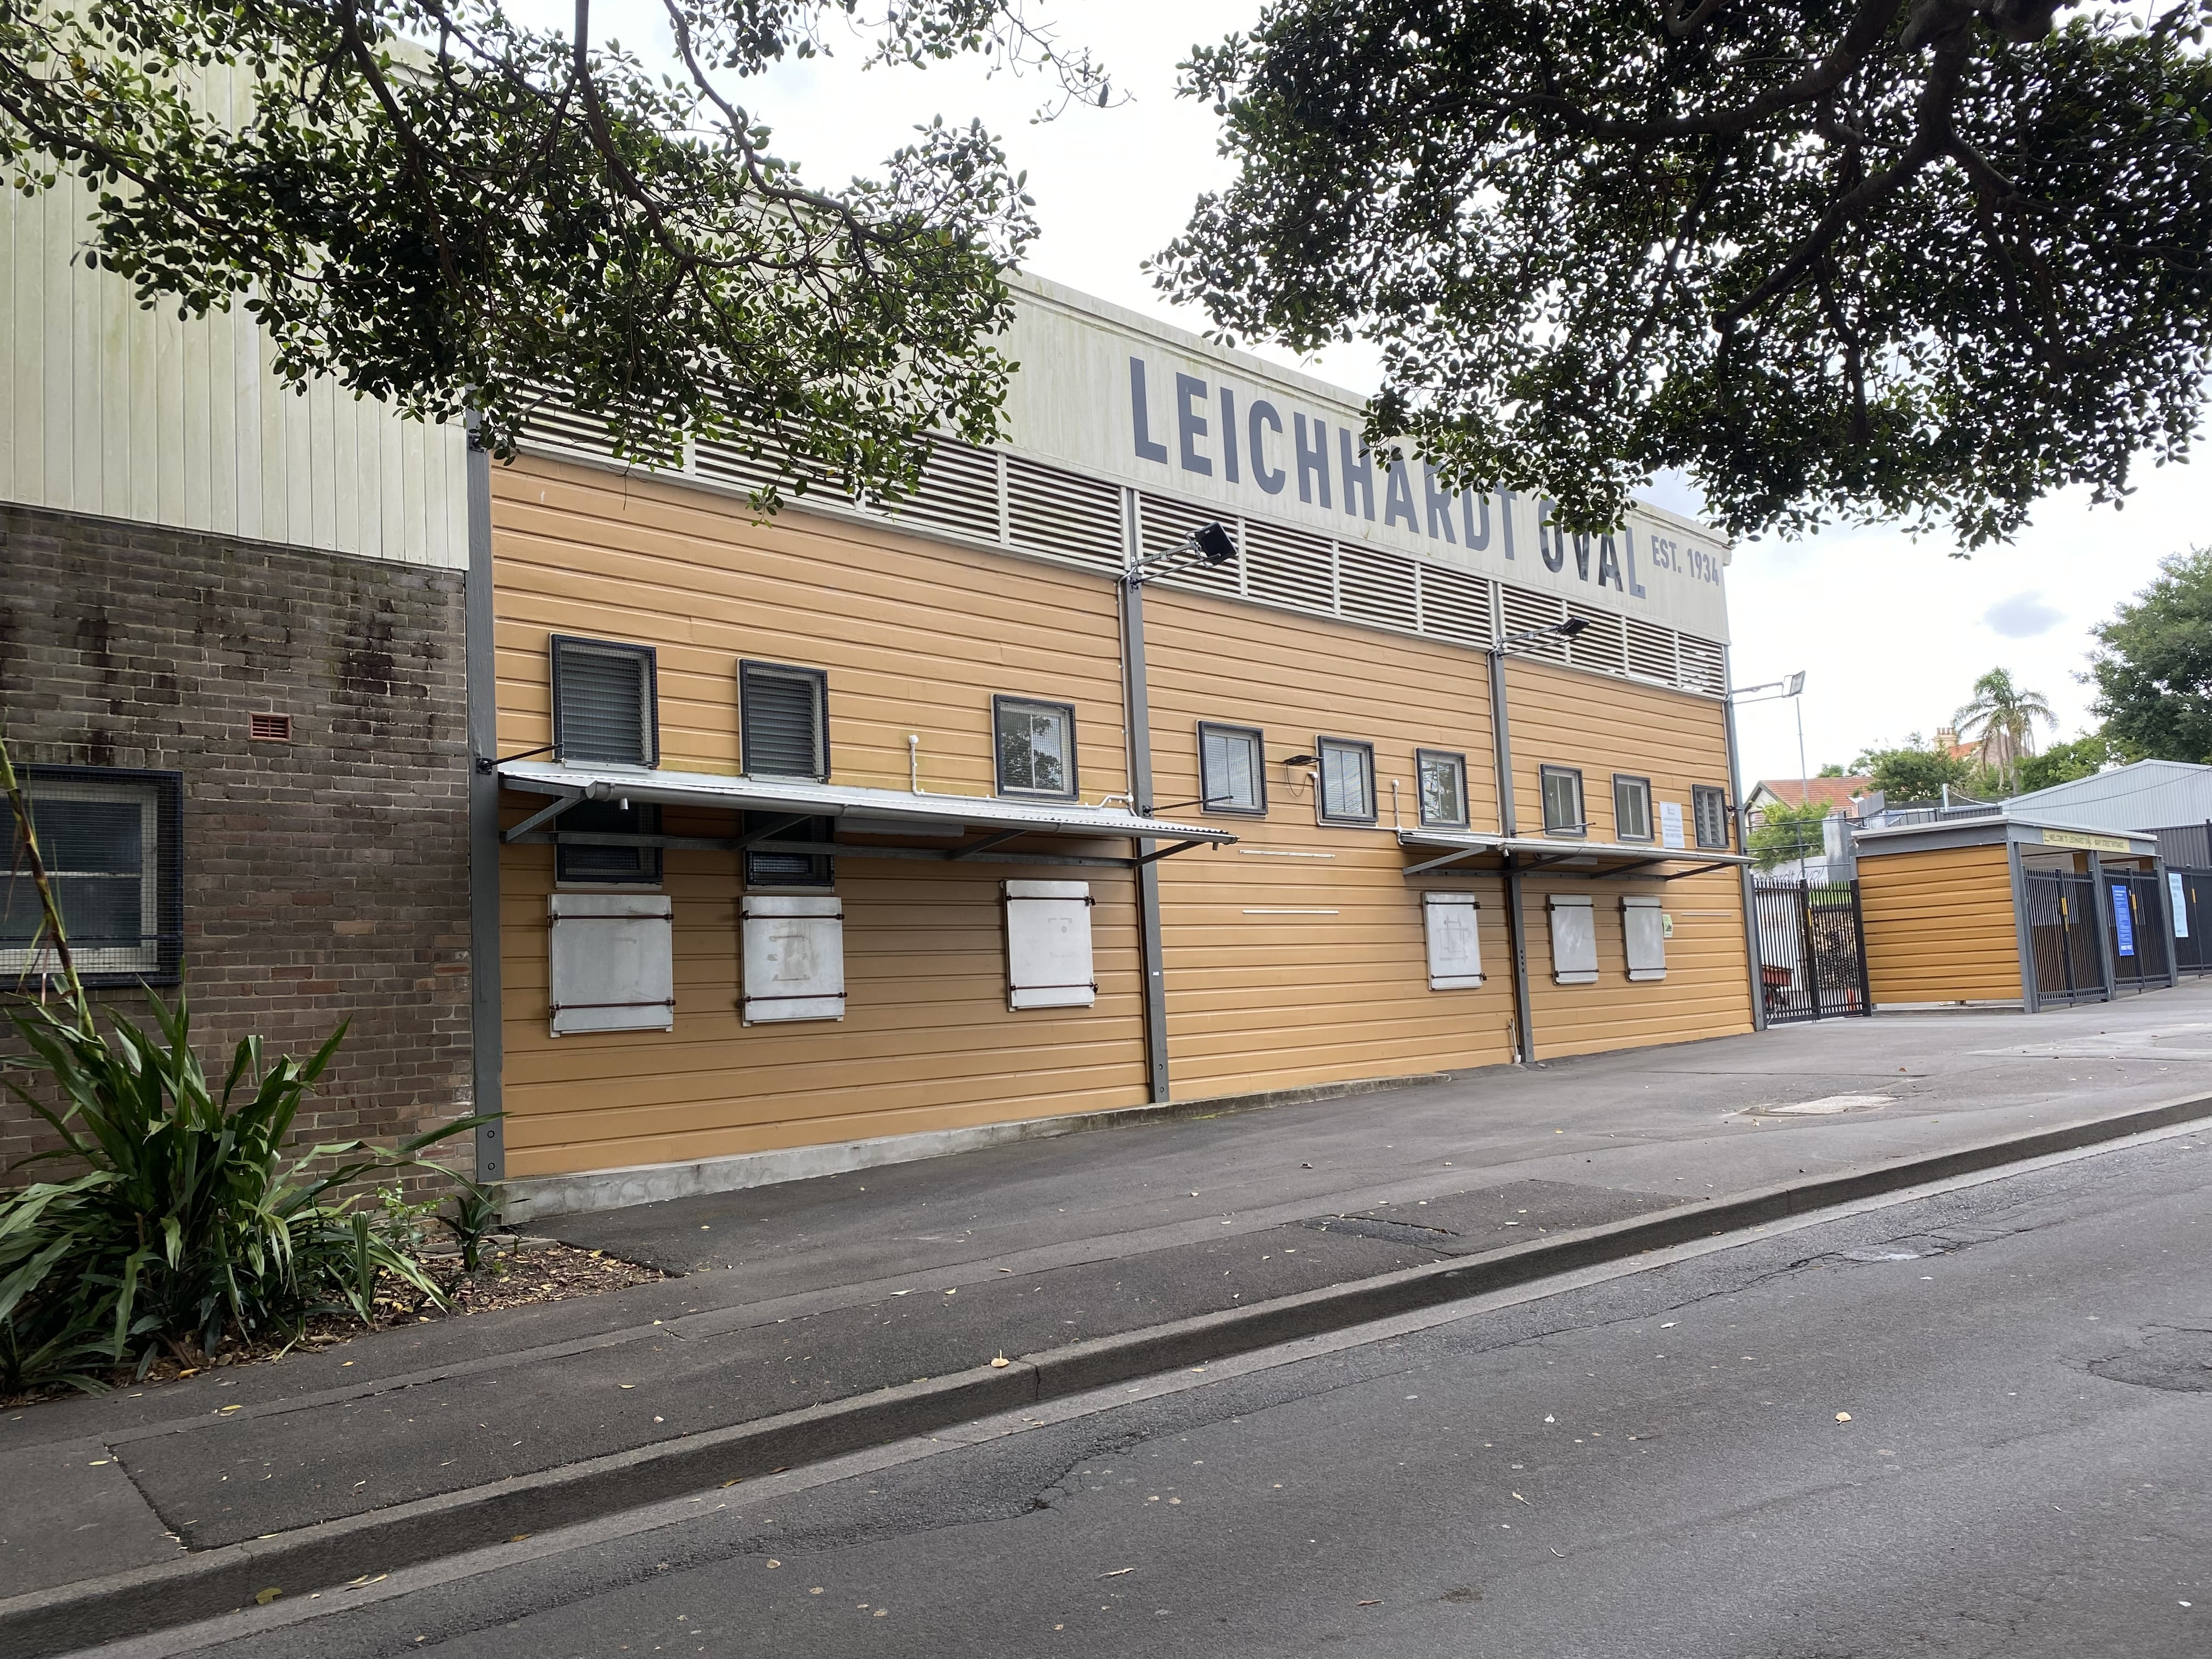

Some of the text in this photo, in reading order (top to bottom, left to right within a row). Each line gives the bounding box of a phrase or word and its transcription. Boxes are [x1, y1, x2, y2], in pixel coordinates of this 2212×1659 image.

[1130, 356, 1719, 599] LEICHHARDT OVAL EST. 1934
